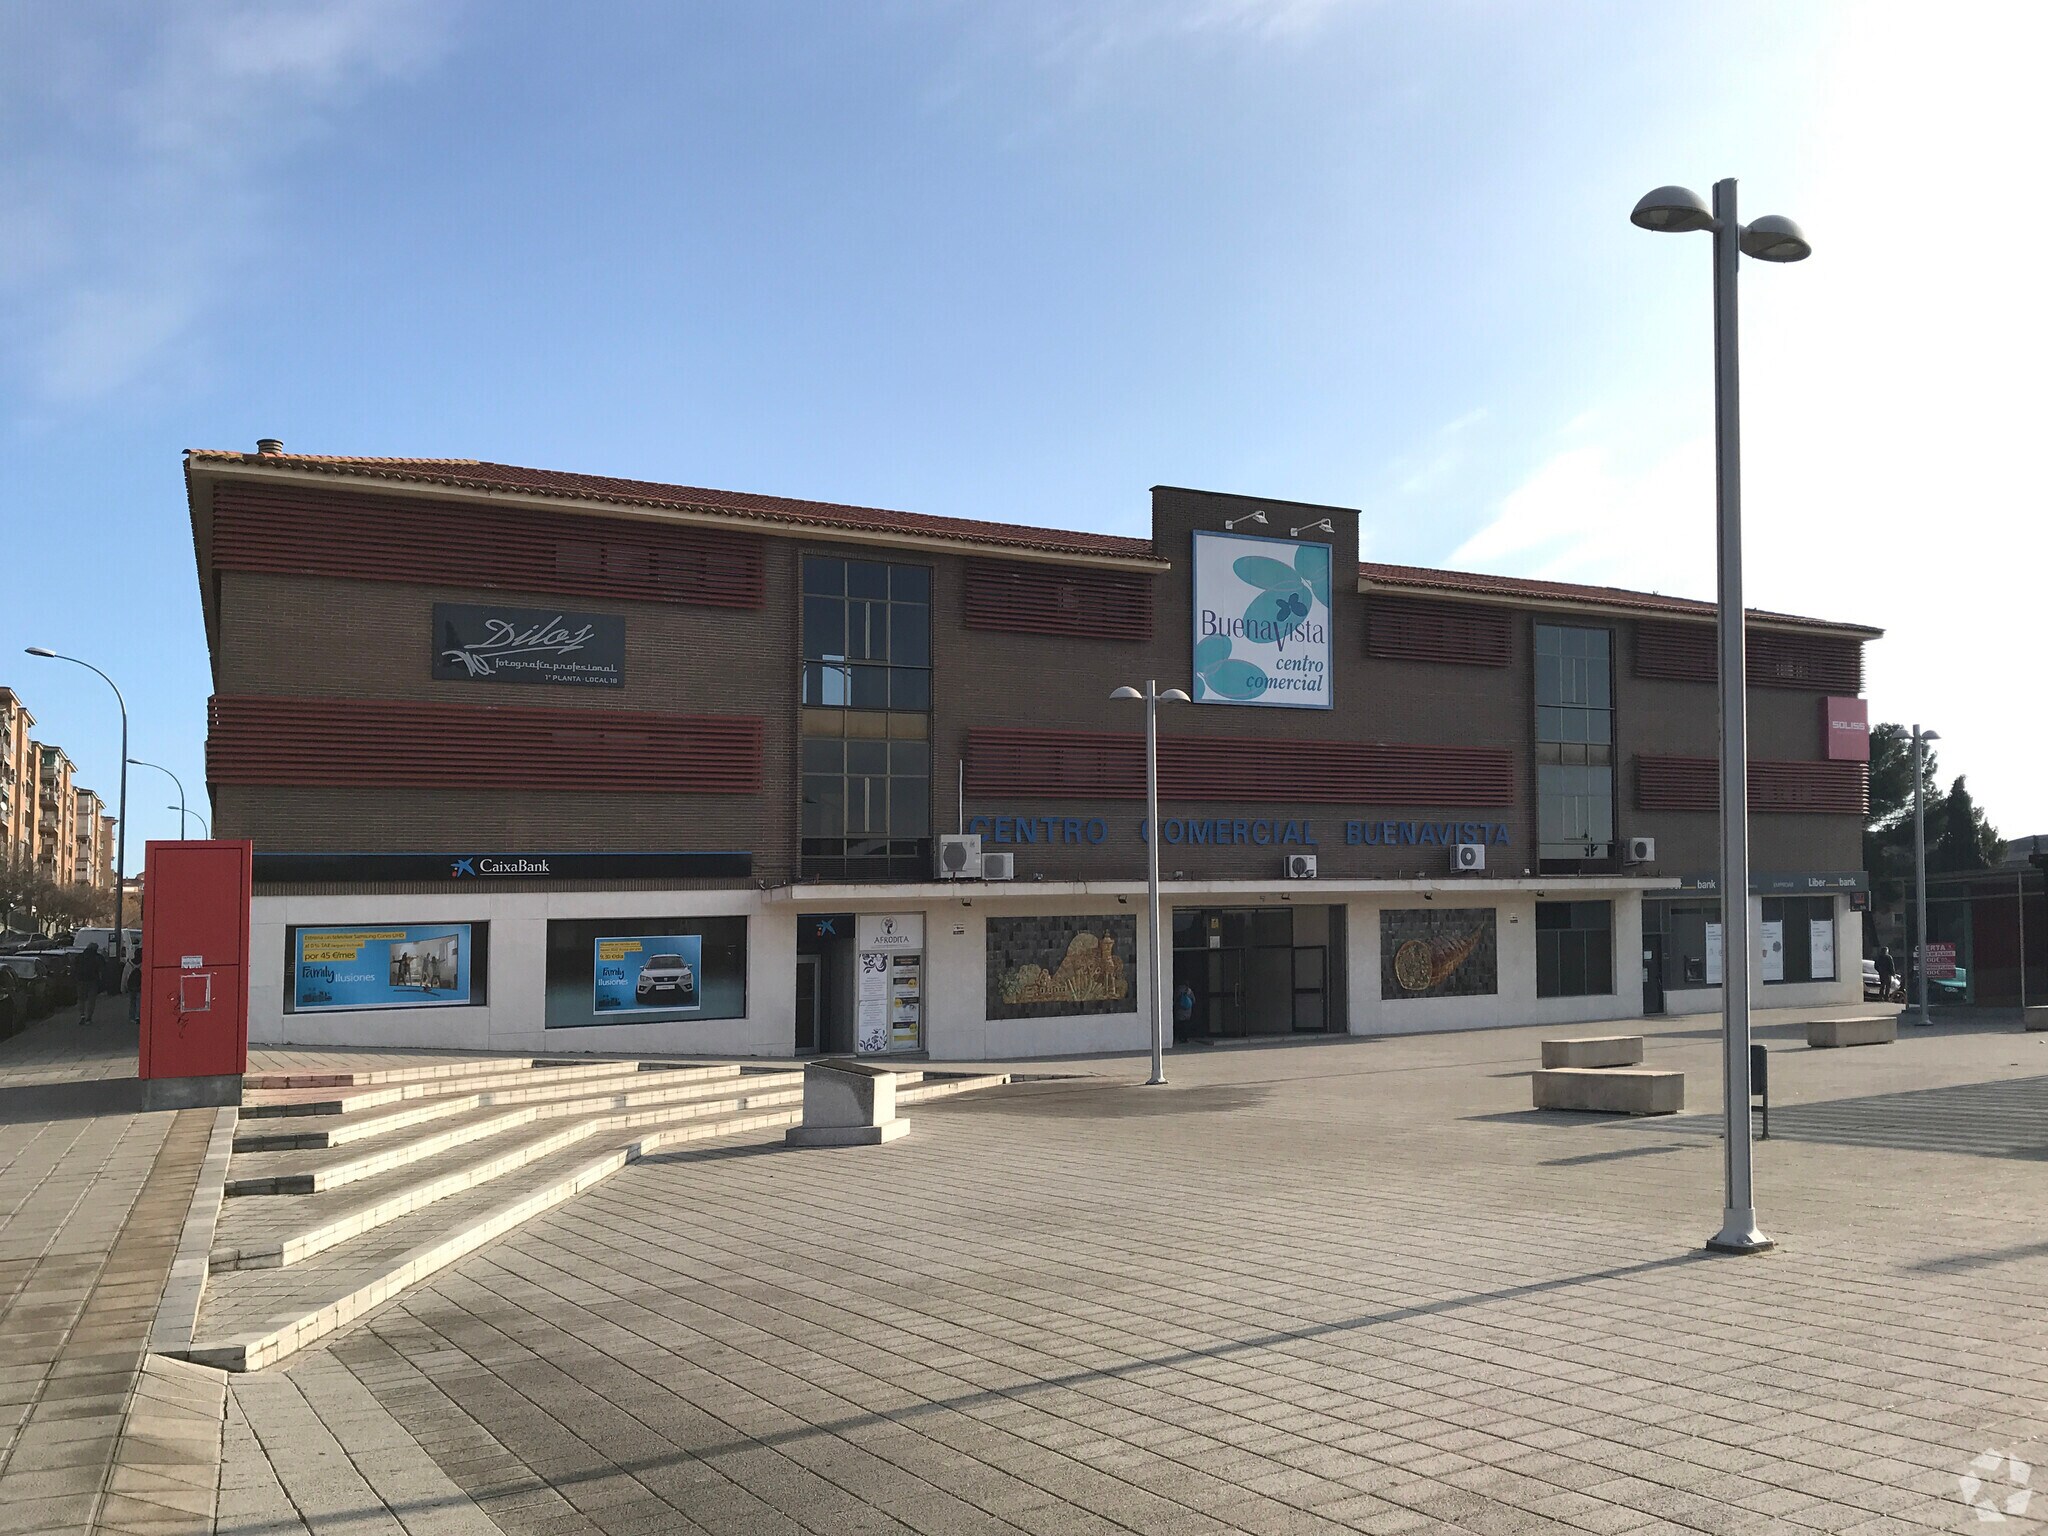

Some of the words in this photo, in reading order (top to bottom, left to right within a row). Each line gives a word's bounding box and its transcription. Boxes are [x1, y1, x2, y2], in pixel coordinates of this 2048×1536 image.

[553, 662, 617, 673] profesional
[1276, 655, 1324, 672] centro
[1246, 675, 1323, 691] comercial
[1832, 721, 1865, 730] SOLISS
[968, 815, 1109, 844] CENTRO
[1346, 820, 1511, 846] BUENAVISTA
[480, 859, 550, 872] CaixaBank
[1697, 879, 1716, 889] bank
[1808, 878, 1826, 887] Liber
[1839, 877, 1856, 886] bank
[873, 936, 910, 944] AFRODITA
[304, 953, 318, 961] por
[332, 951, 355, 959] €/mes
[302, 965, 335, 983] Family
[335, 973, 375, 983] Ilusiones
[602, 967, 624, 979] Family
